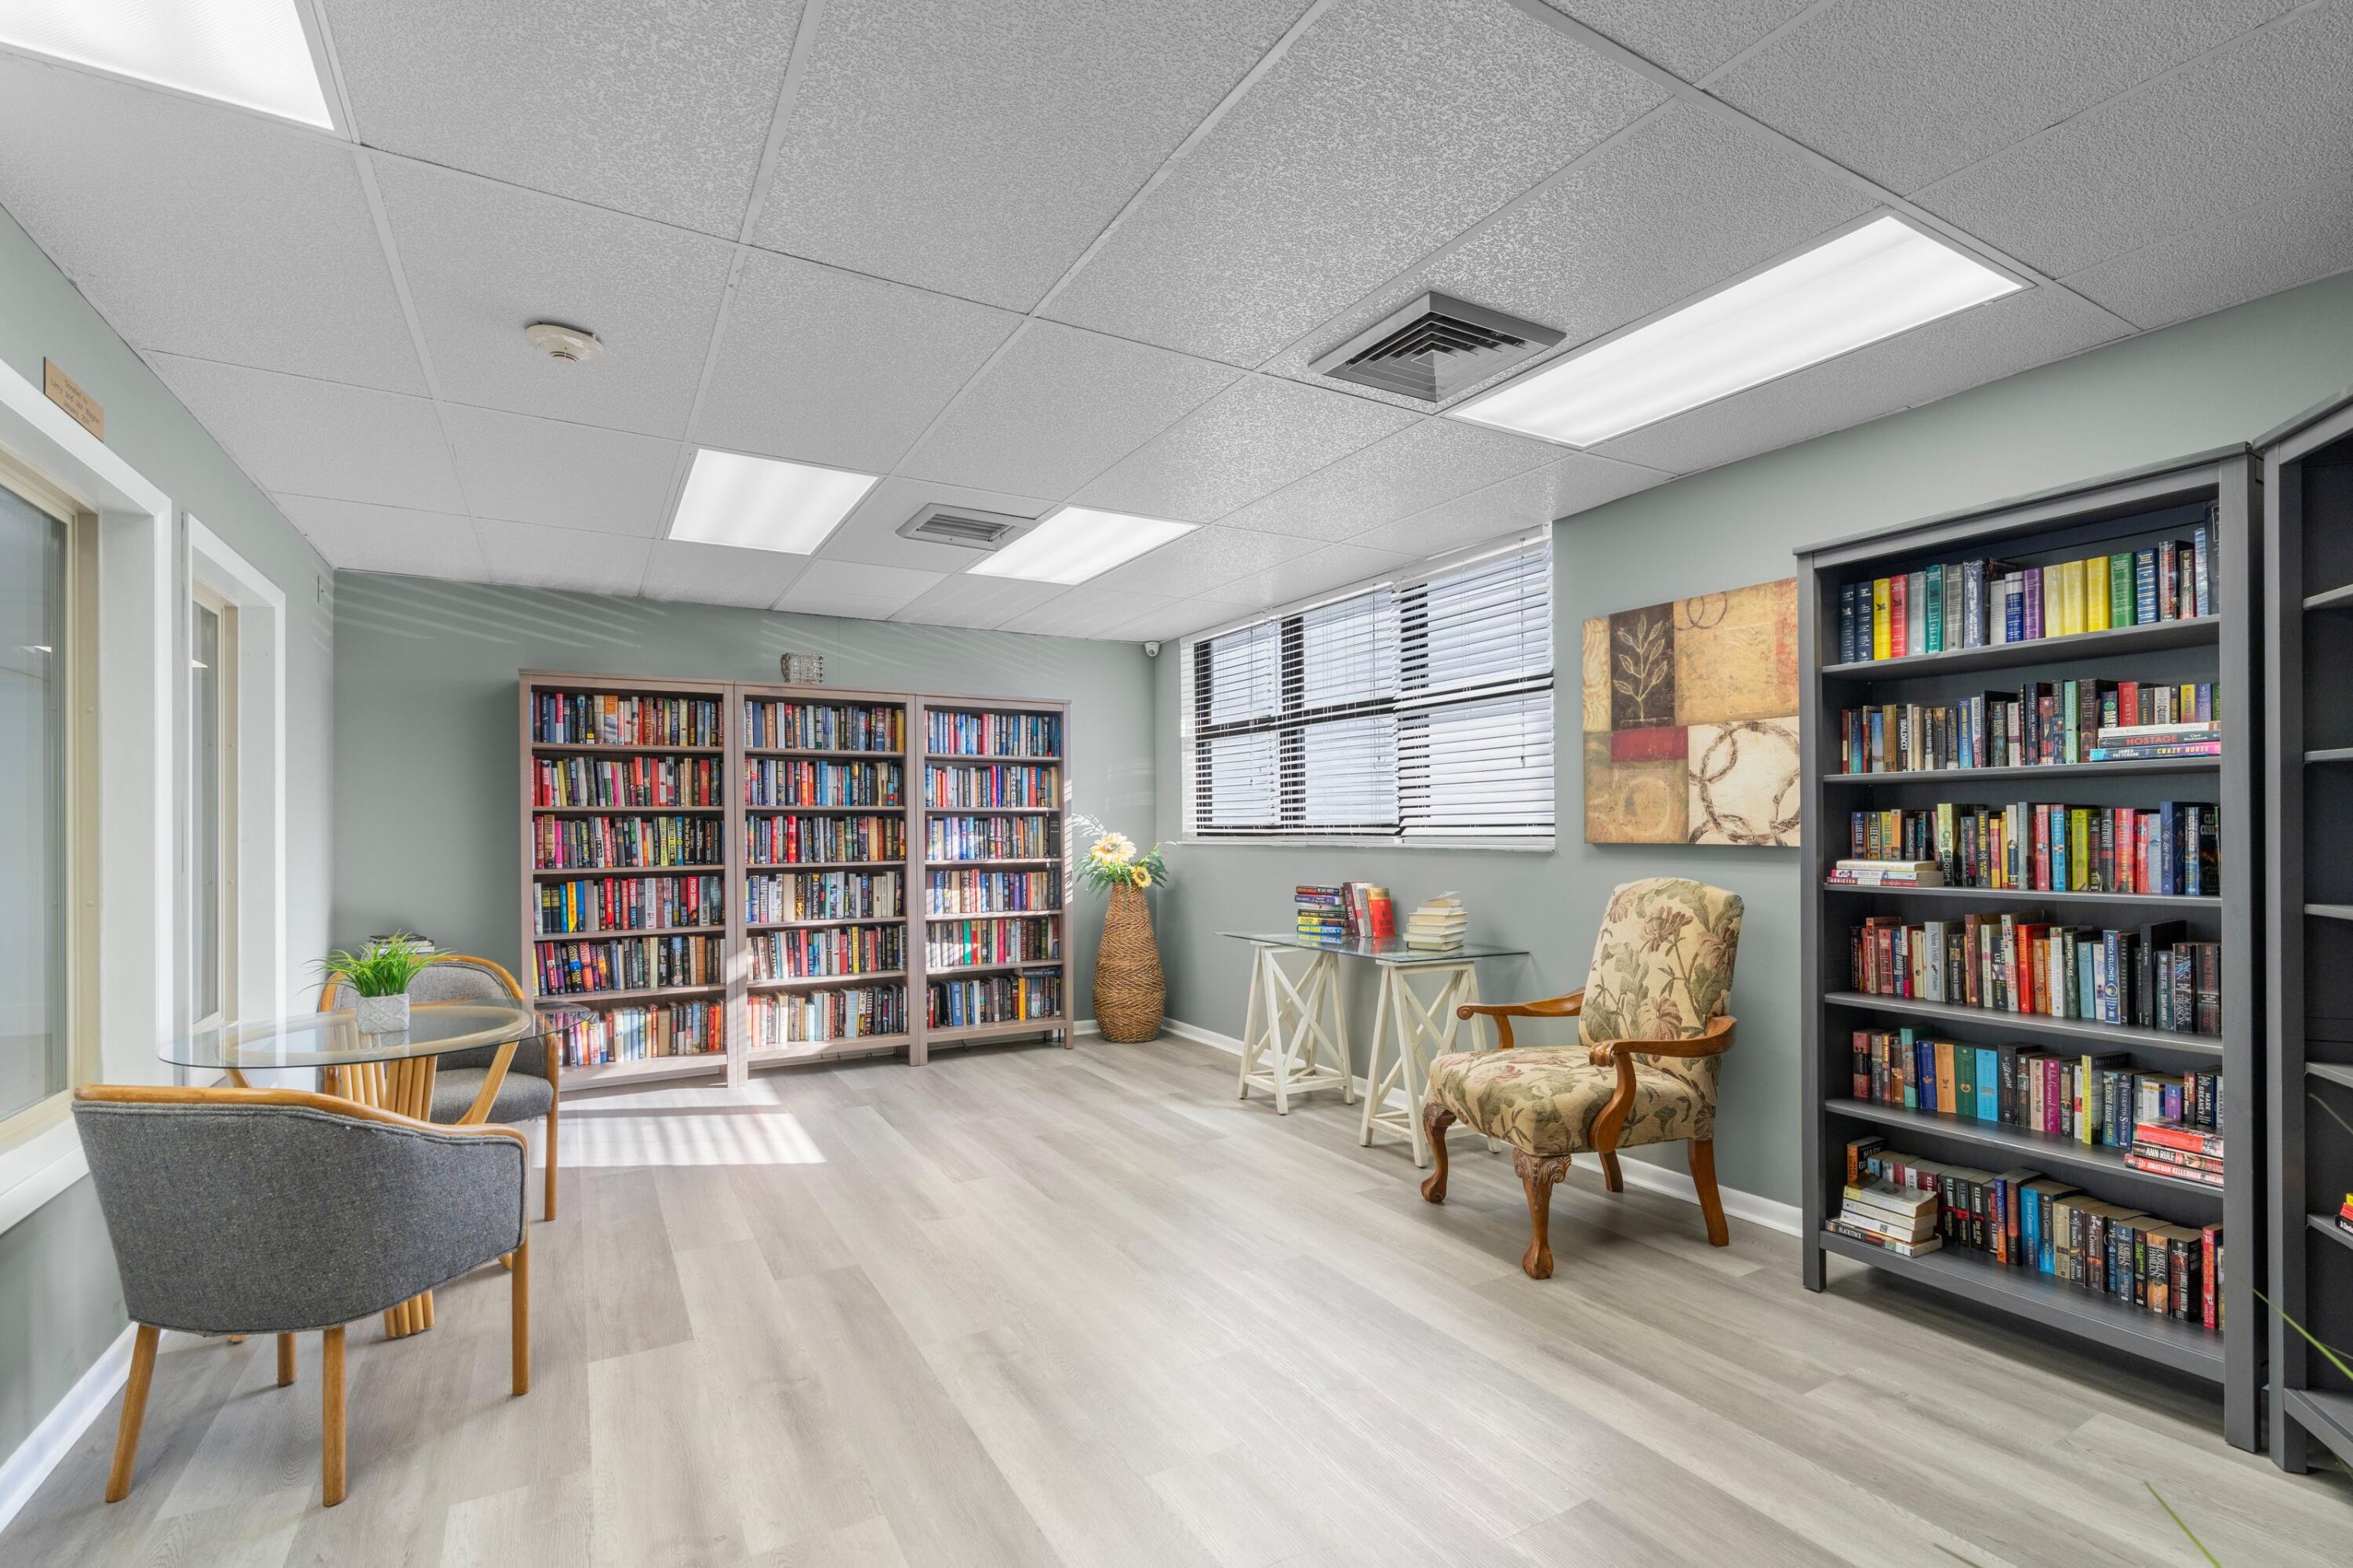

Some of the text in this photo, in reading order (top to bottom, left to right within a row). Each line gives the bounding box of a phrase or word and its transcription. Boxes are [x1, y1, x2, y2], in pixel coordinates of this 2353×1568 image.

[2104, 711, 2116, 722] DAN
[2126, 735, 2178, 746] HOSTAGE
[2185, 745, 2209, 754] HOUSE
[1870, 828, 1878, 849] LEE CHILD
[2102, 820, 2113, 847] Cornwell
[1944, 858, 1953, 882] Bones
[2176, 994, 2184, 1024] TREASON
[2046, 1082, 2057, 1105] Garwood
[2105, 1084, 2114, 1122] HEATHER GRAHAM
[2107, 1123, 2115, 1143] FLAWLESS
[2145, 1148, 2176, 1162] ANN RULE
[2147, 1162, 2172, 1173] JONATHAN
[2172, 1167, 2202, 1180] KELLERMAN
[2089, 1235, 2097, 1256] CHAMBER
